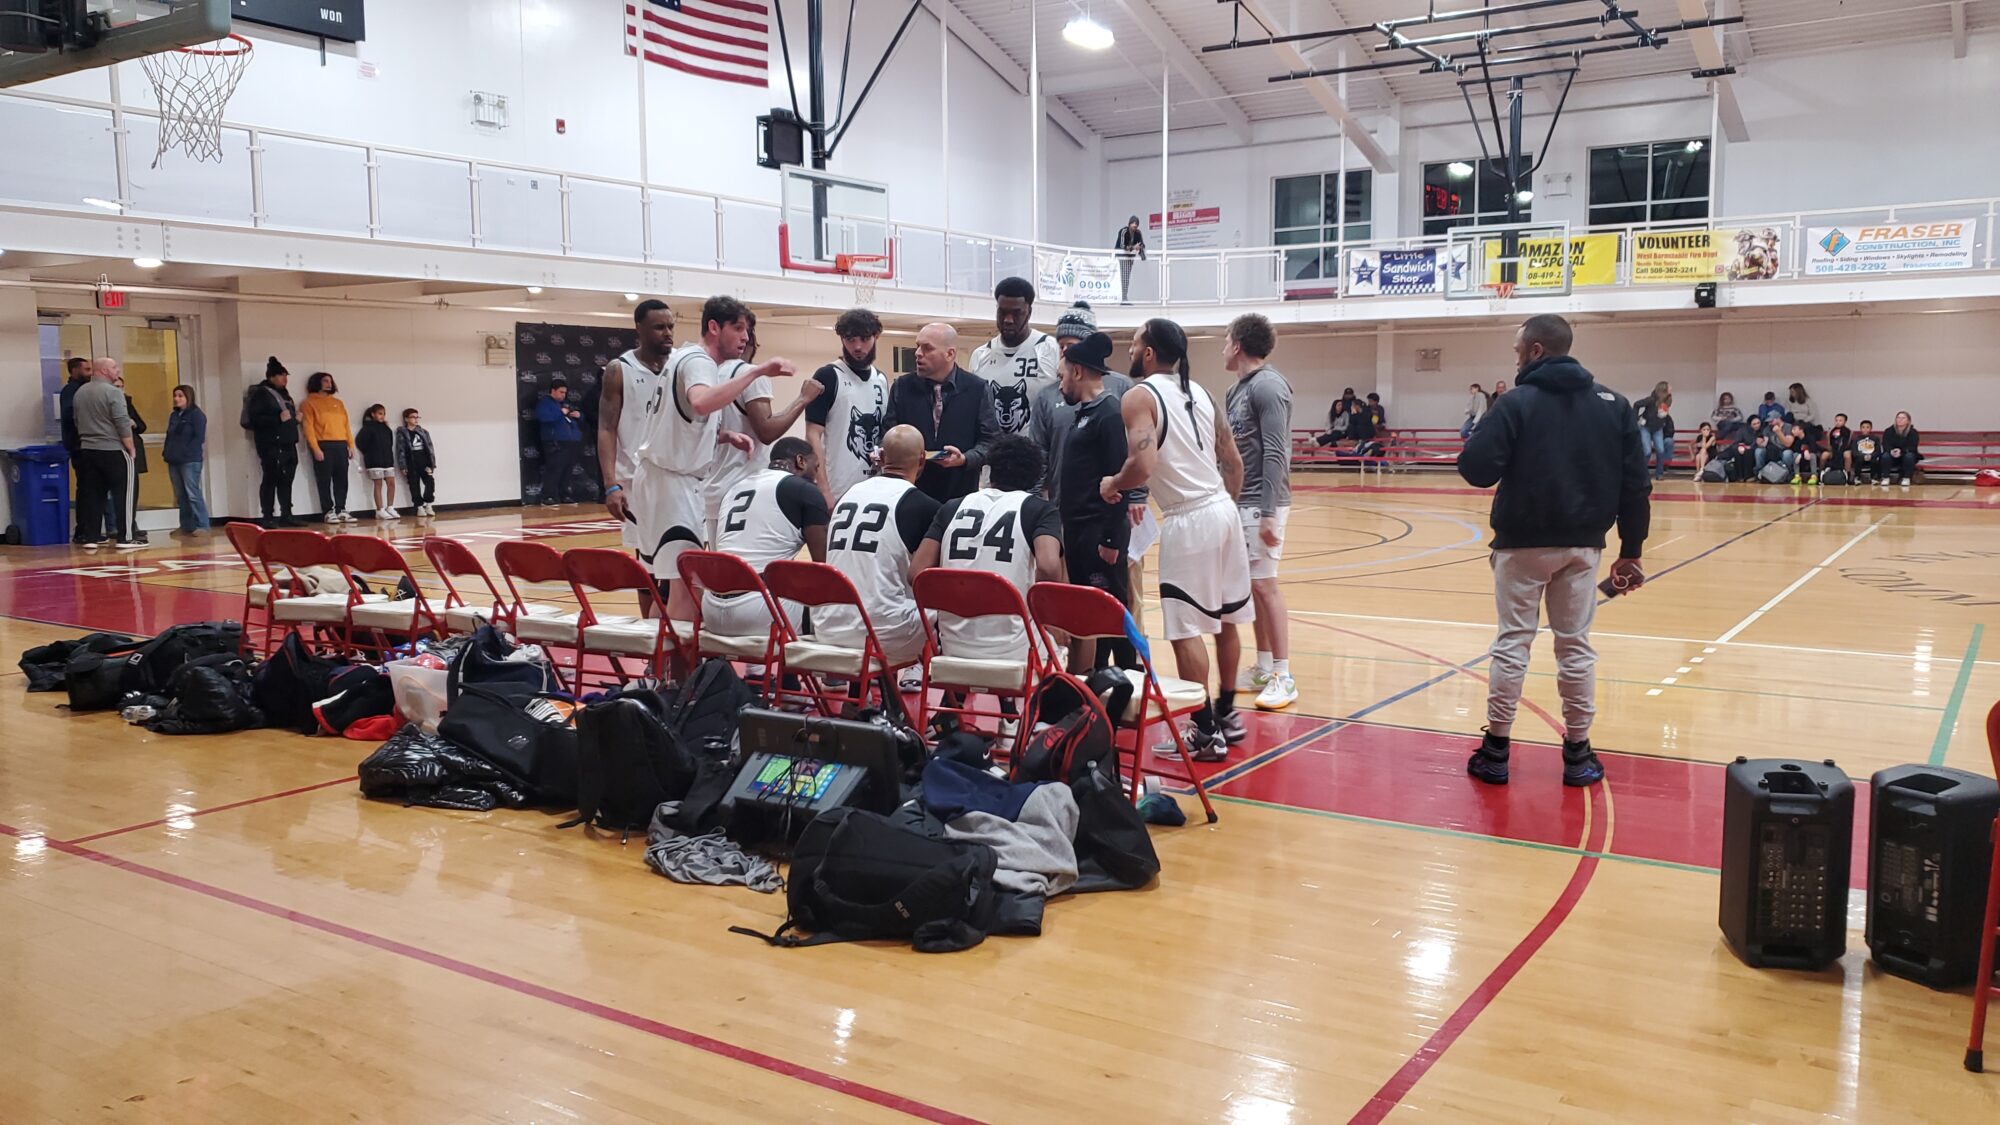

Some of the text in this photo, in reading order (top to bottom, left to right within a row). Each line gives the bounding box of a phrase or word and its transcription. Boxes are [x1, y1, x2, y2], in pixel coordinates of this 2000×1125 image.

[320, 7, 342, 23] won
[1858, 223, 1964, 241] FRASER
[1638, 235, 1710, 249] VOLUNTEER
[1393, 252, 1424, 260] Little
[1930, 250, 1968, 258] Remodeling
[1382, 261, 1434, 274] Sandwich
[103, 291, 125, 307] EXIT
[1014, 357, 1038, 377] 32
[873, 384, 883, 405] 3
[724, 489, 756, 533] 2
[828, 502, 889, 553] 22
[949, 508, 1017, 563] 24
